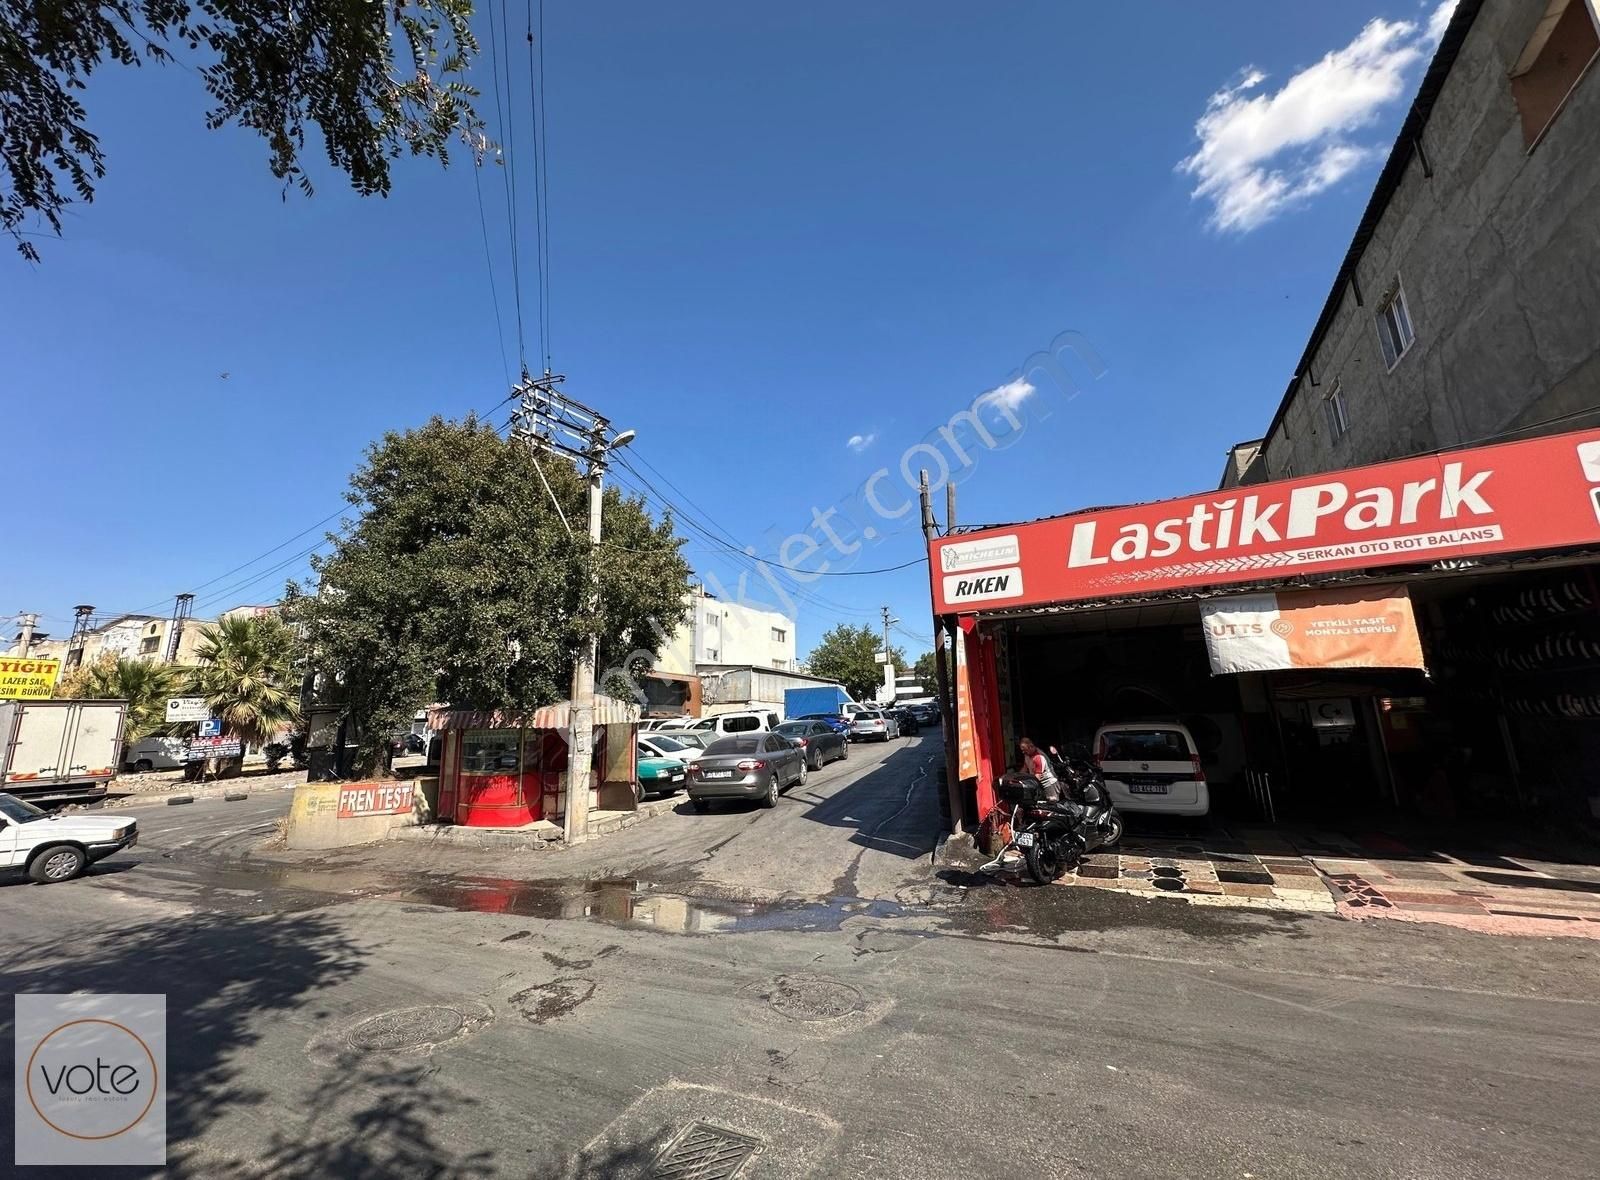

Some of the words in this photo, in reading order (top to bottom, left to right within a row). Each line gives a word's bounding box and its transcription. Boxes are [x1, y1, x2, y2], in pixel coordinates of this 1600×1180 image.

[1297, 546, 1355, 561] SERKAN
[1360, 542, 1390, 554] OTO
[1394, 537, 1423, 549] ROT
[1427, 529, 1494, 546] BALANS
[959, 547, 1015, 562] MICHELIN
[1212, 623, 1264, 637] UTTS
[1305, 627, 1350, 637] MONTAJ
[2, 677, 28, 685] LAZER
[340, 789, 376, 812] FREN
